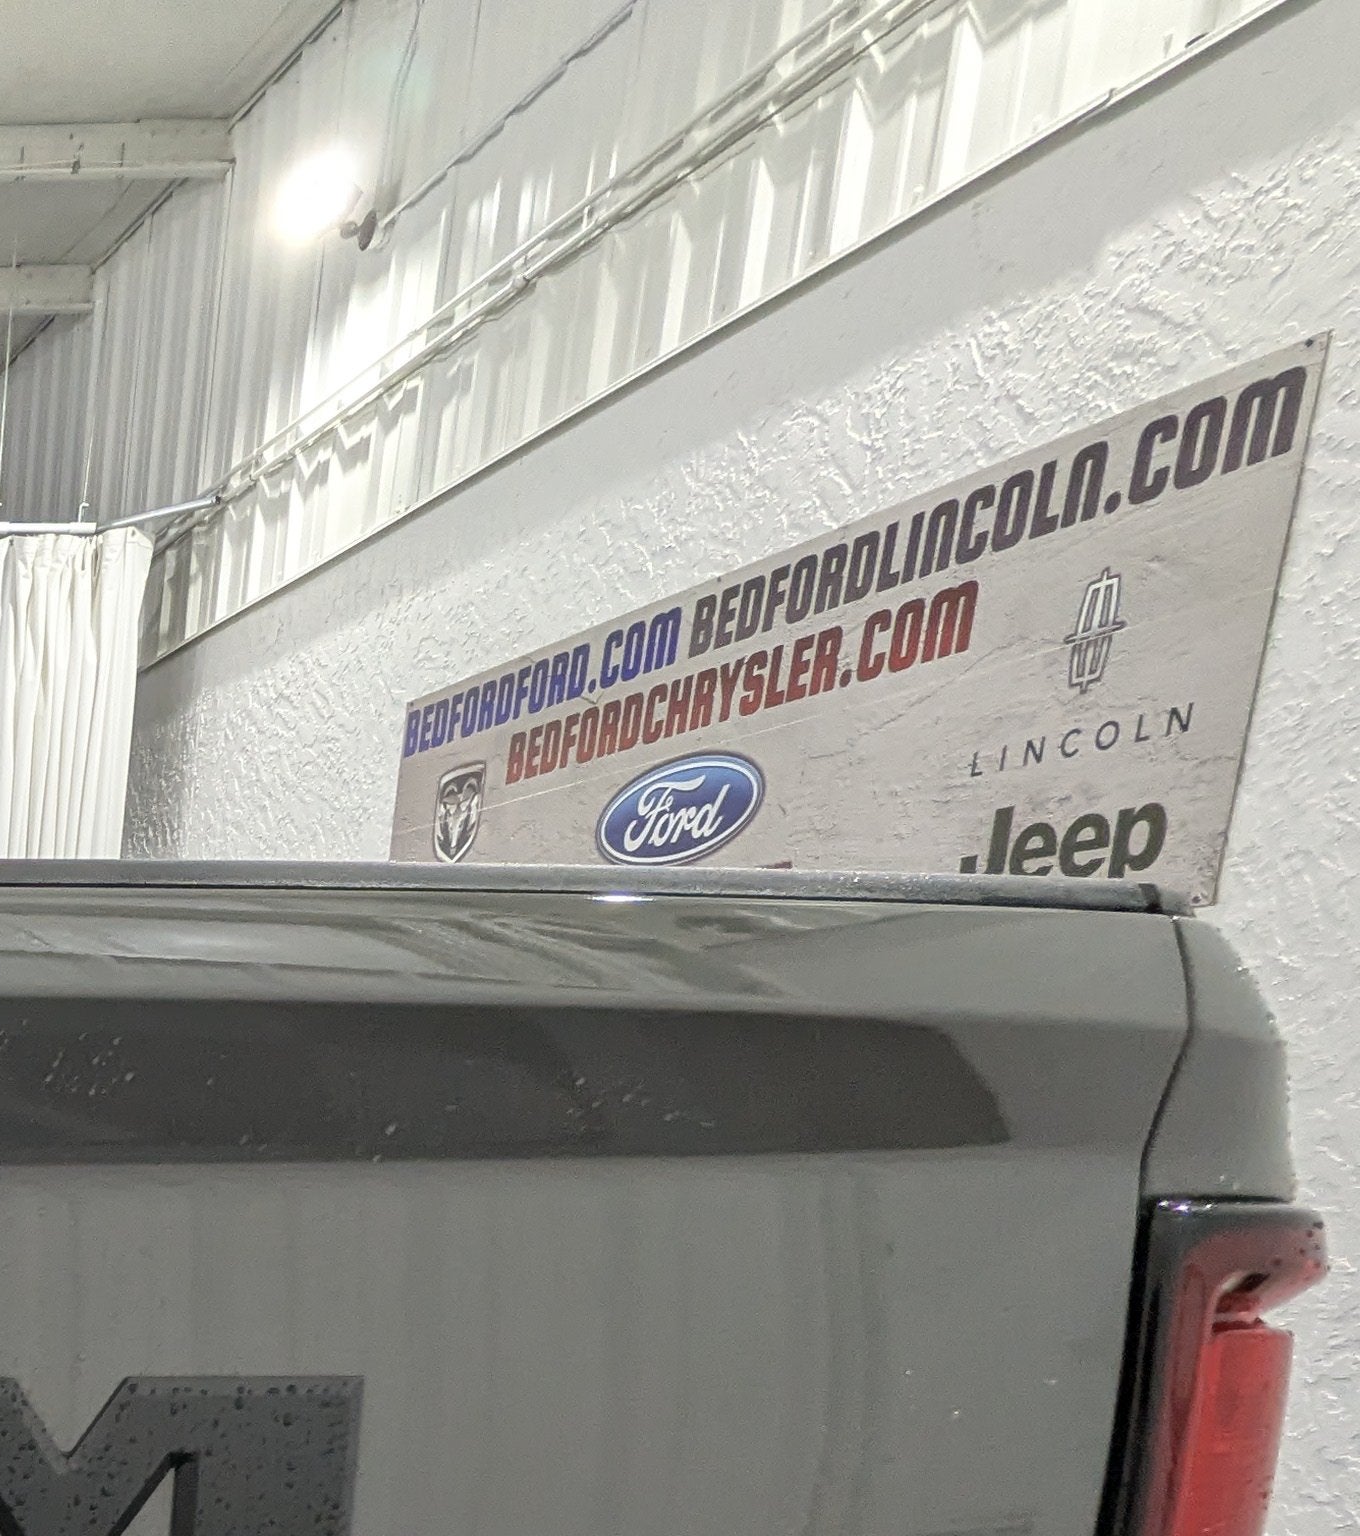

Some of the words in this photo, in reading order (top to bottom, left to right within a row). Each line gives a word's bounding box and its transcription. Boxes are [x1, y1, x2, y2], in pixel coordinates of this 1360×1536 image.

[403, 606, 683, 759] BEDFORDFORD.COM
[687, 365, 1308, 661] BEDFORDLINCOLN.COM
[504, 579, 980, 786] BEDFORDCHRYSLER.COM
[969, 701, 1195, 778] LINCOLN
[622, 773, 732, 854] Ford
[959, 801, 1168, 879] Jeep
